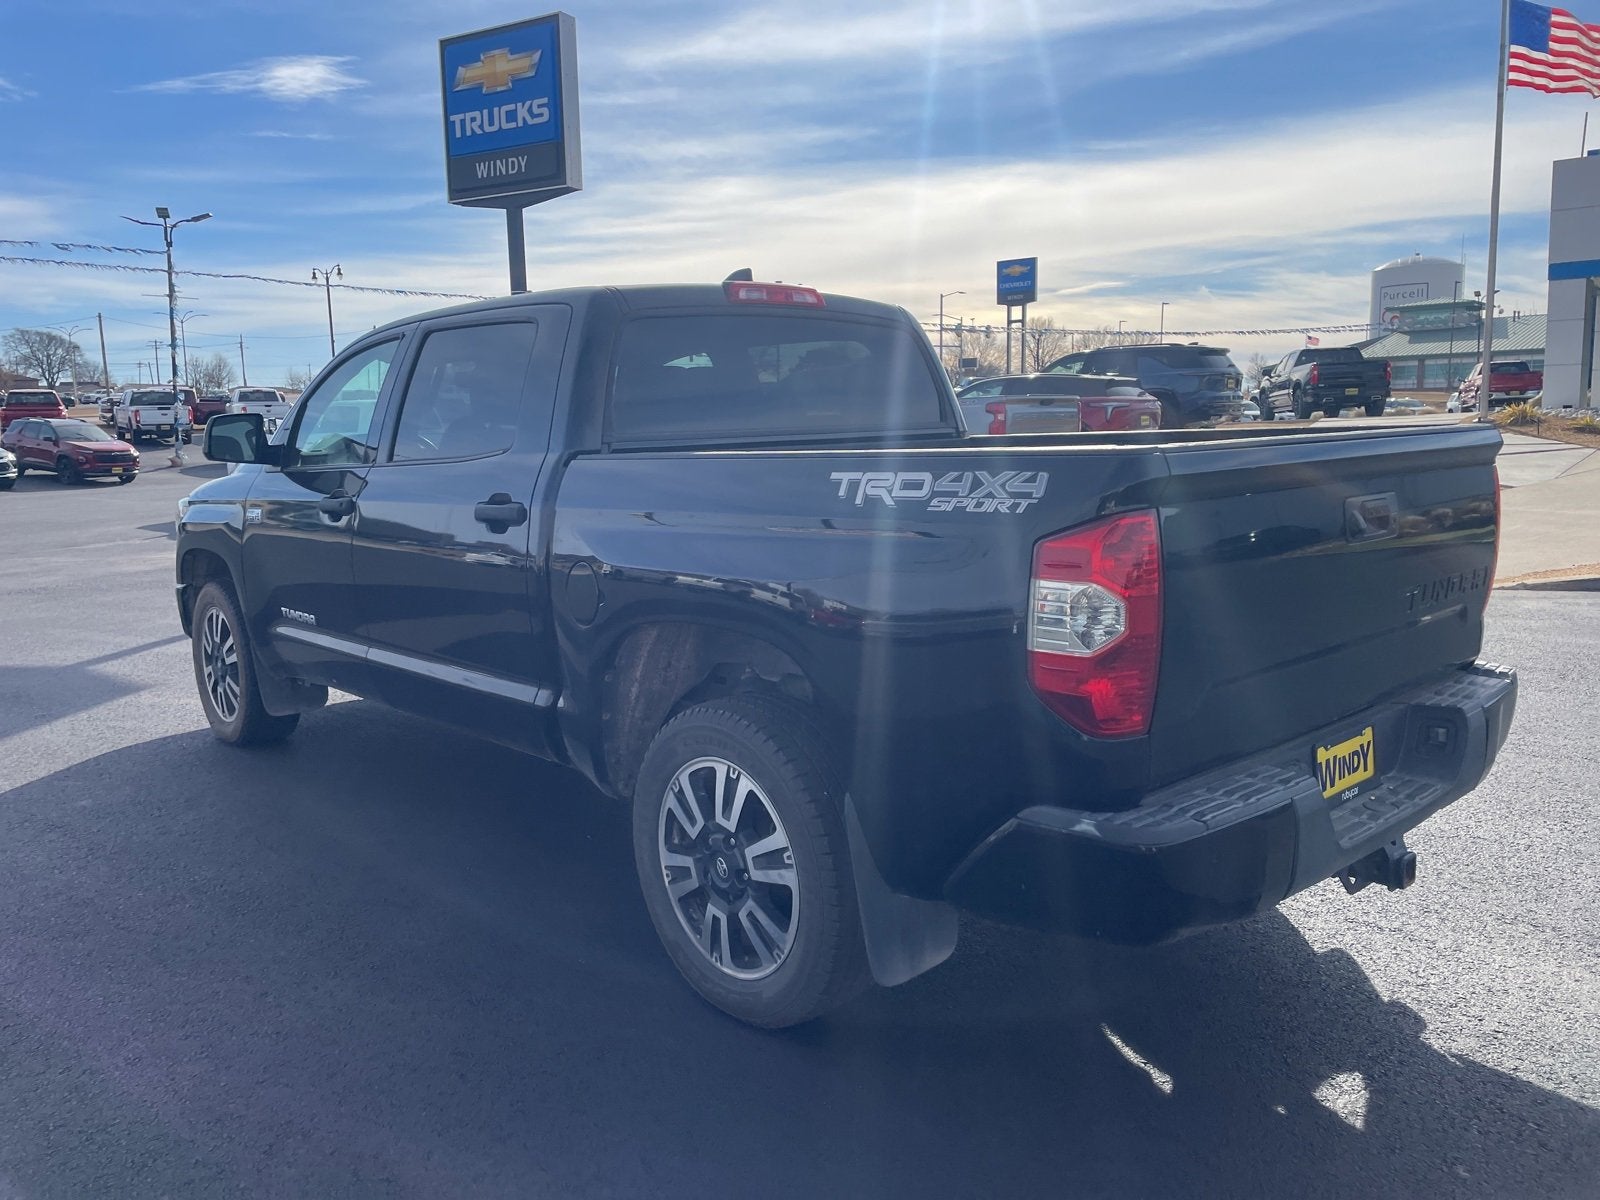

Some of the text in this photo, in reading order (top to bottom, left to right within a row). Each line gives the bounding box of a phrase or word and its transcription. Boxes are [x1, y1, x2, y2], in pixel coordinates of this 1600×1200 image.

[449, 97, 550, 138] TRUCKS
[476, 155, 528, 179] WINDY
[1383, 288, 1424, 300] Purcell
[830, 471, 935, 508] TRD
[926, 497, 1039, 514] SPORT
[280, 607, 317, 626] TUNDRA
[1317, 739, 1372, 793] WINDY
